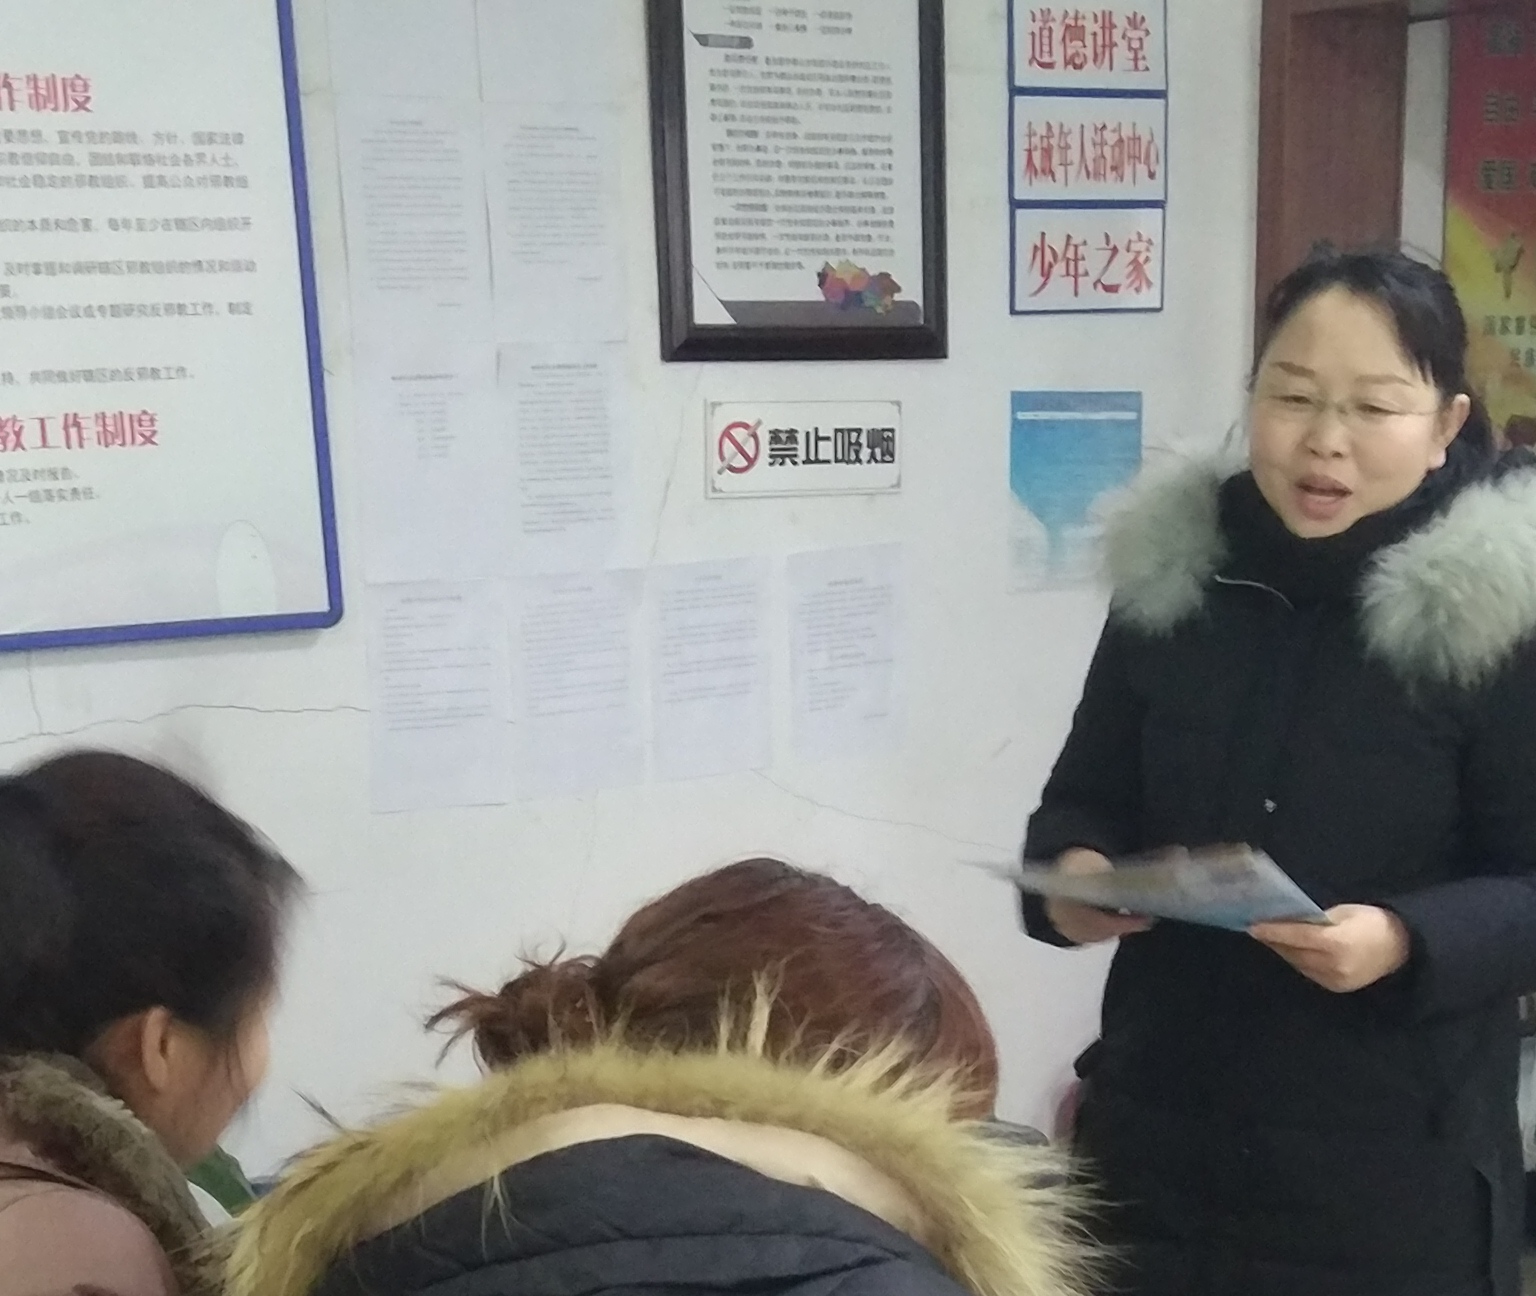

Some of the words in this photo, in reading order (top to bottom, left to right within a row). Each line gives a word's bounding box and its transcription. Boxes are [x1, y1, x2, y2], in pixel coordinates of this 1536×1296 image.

[1028, 8, 1151, 72] 道德讲堂
[1024, 121, 1159, 186] 未成年人活动中心
[1029, 231, 1153, 298] 少年之家
[768, 427, 896, 467] 禁止吸烟
